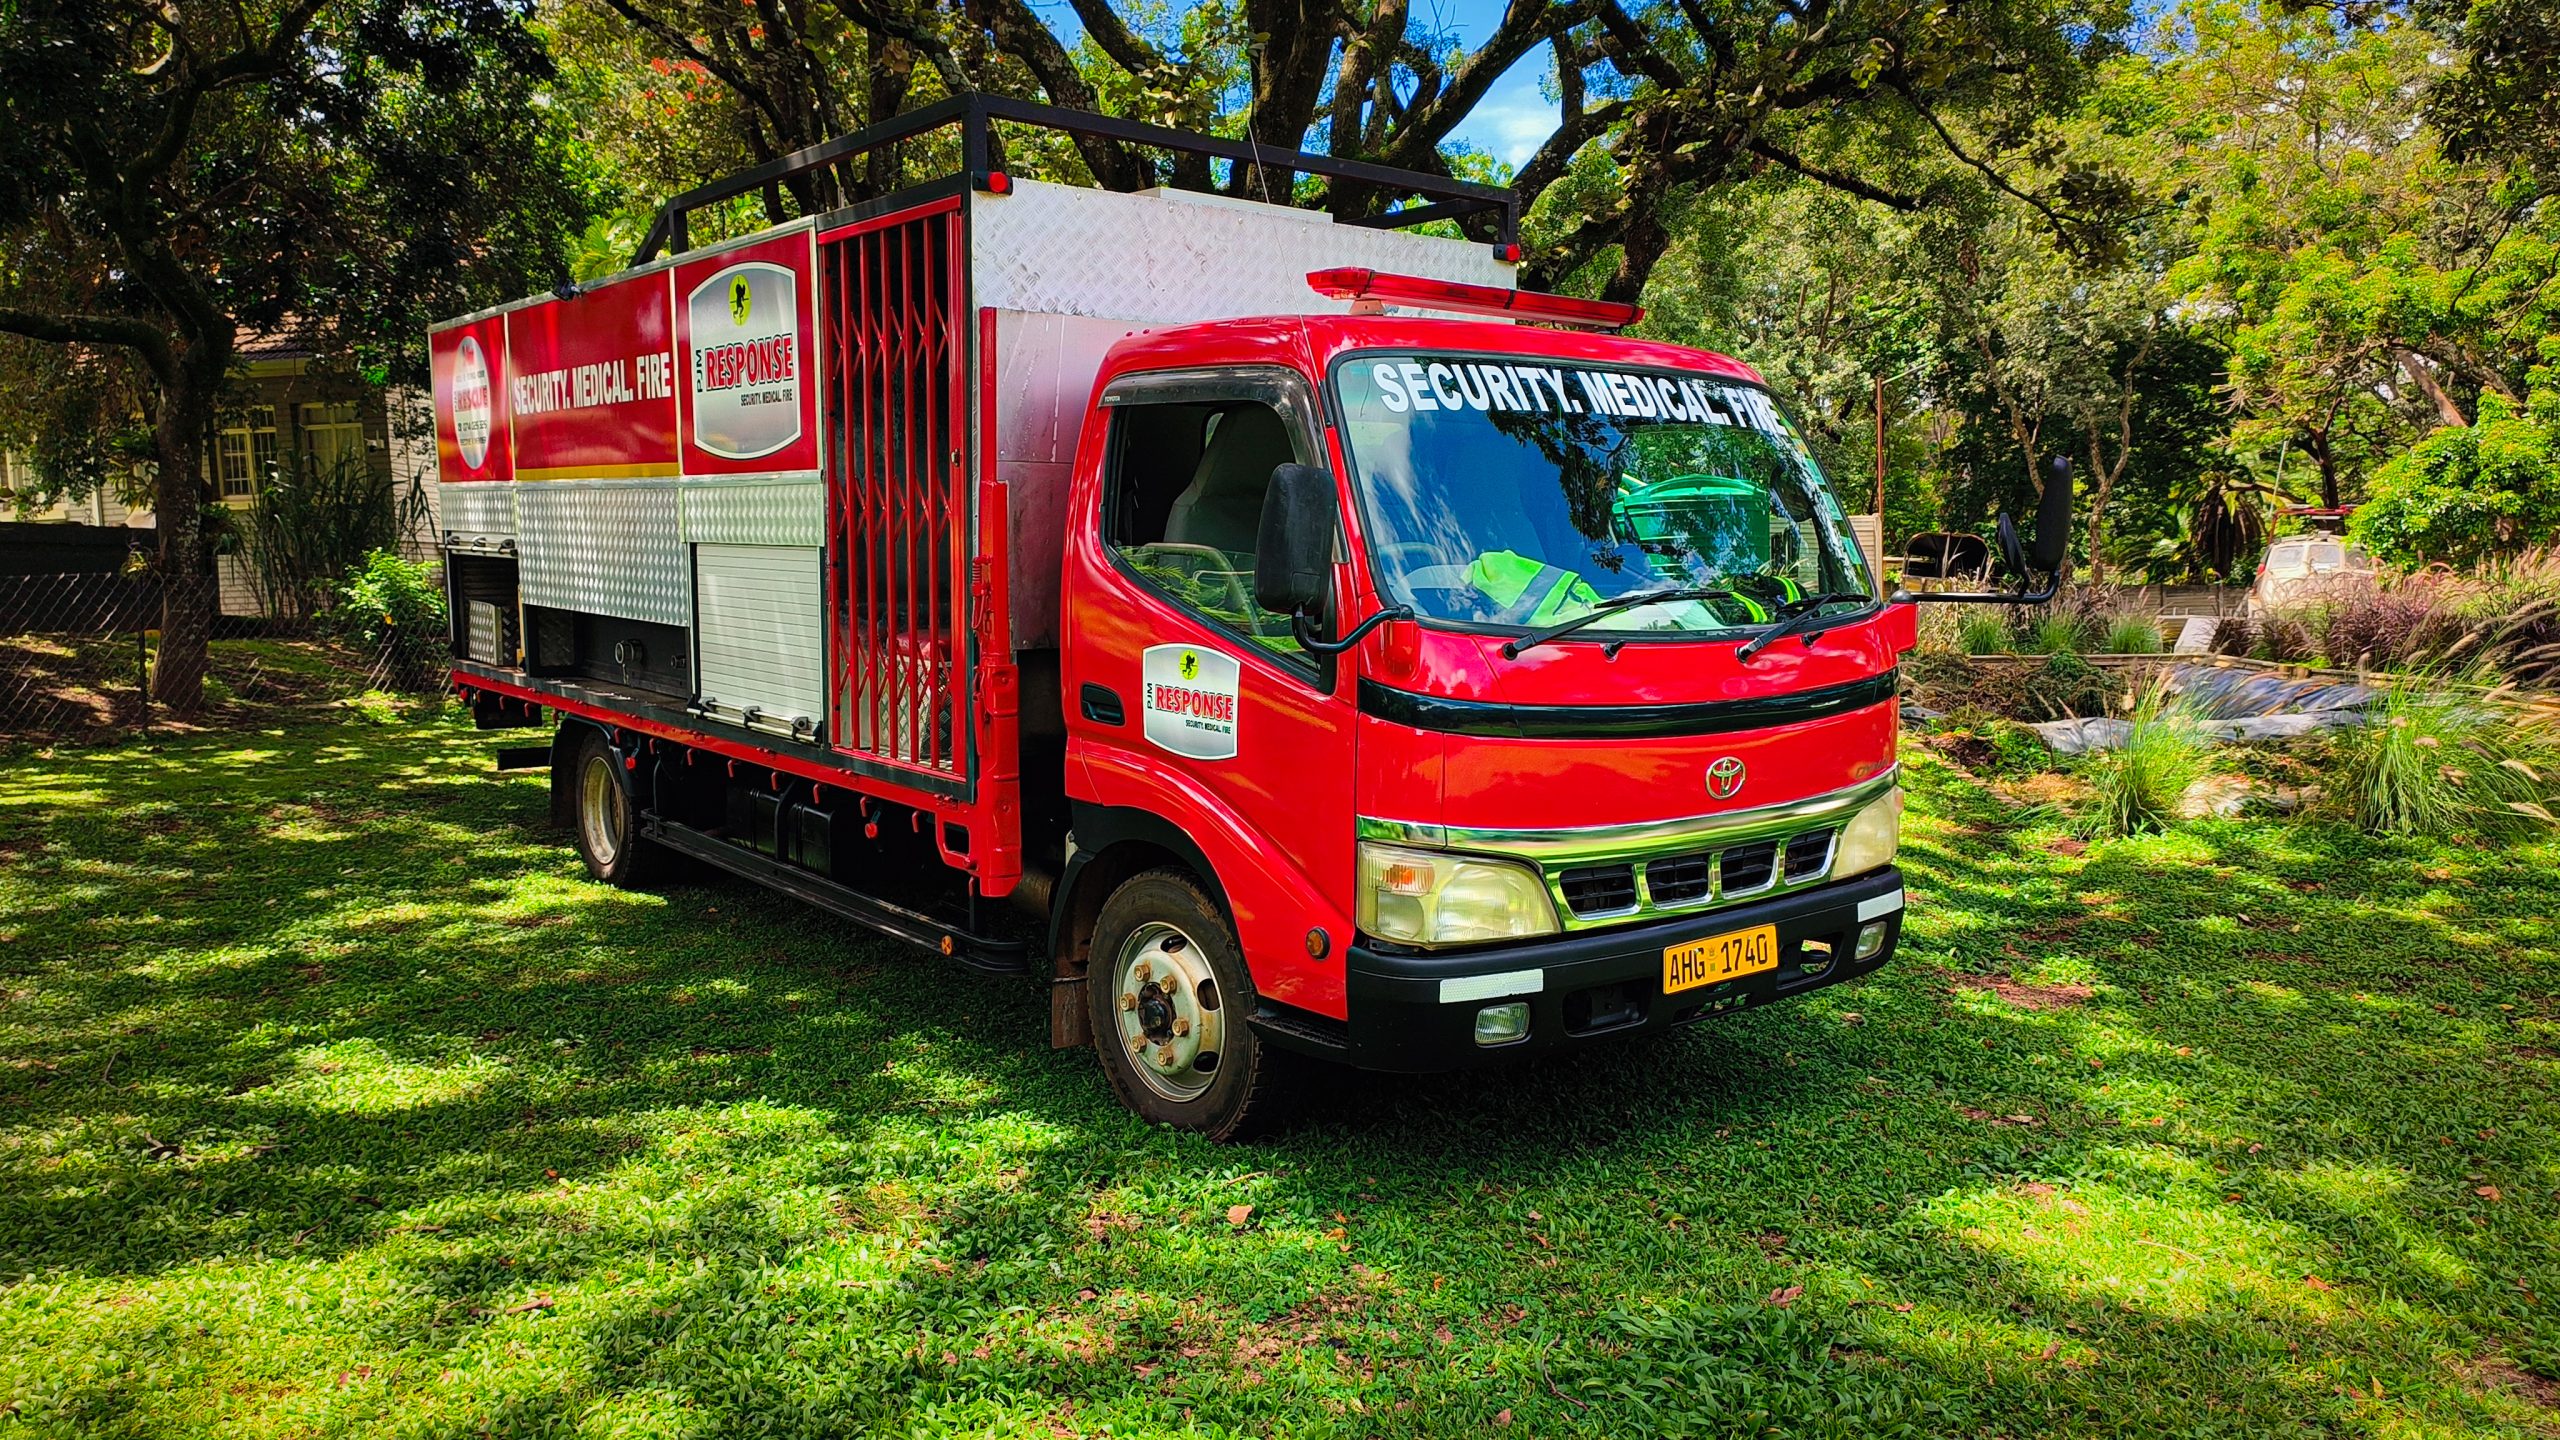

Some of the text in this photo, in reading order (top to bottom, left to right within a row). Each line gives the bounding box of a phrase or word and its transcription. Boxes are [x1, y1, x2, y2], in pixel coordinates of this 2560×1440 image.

[513, 369, 570, 416] SECURITY.
[572, 359, 634, 409] MEDICAL.
[636, 351, 671, 401] FIRE
[704, 333, 794, 391] RESPONSE
[782, 388, 792, 402] FIRE
[1373, 363, 1789, 437] SECURITY. MEDICAL. FIRE
[1155, 684, 1234, 722] RESPONSE
[1669, 933, 1768, 987] AHG 1740
